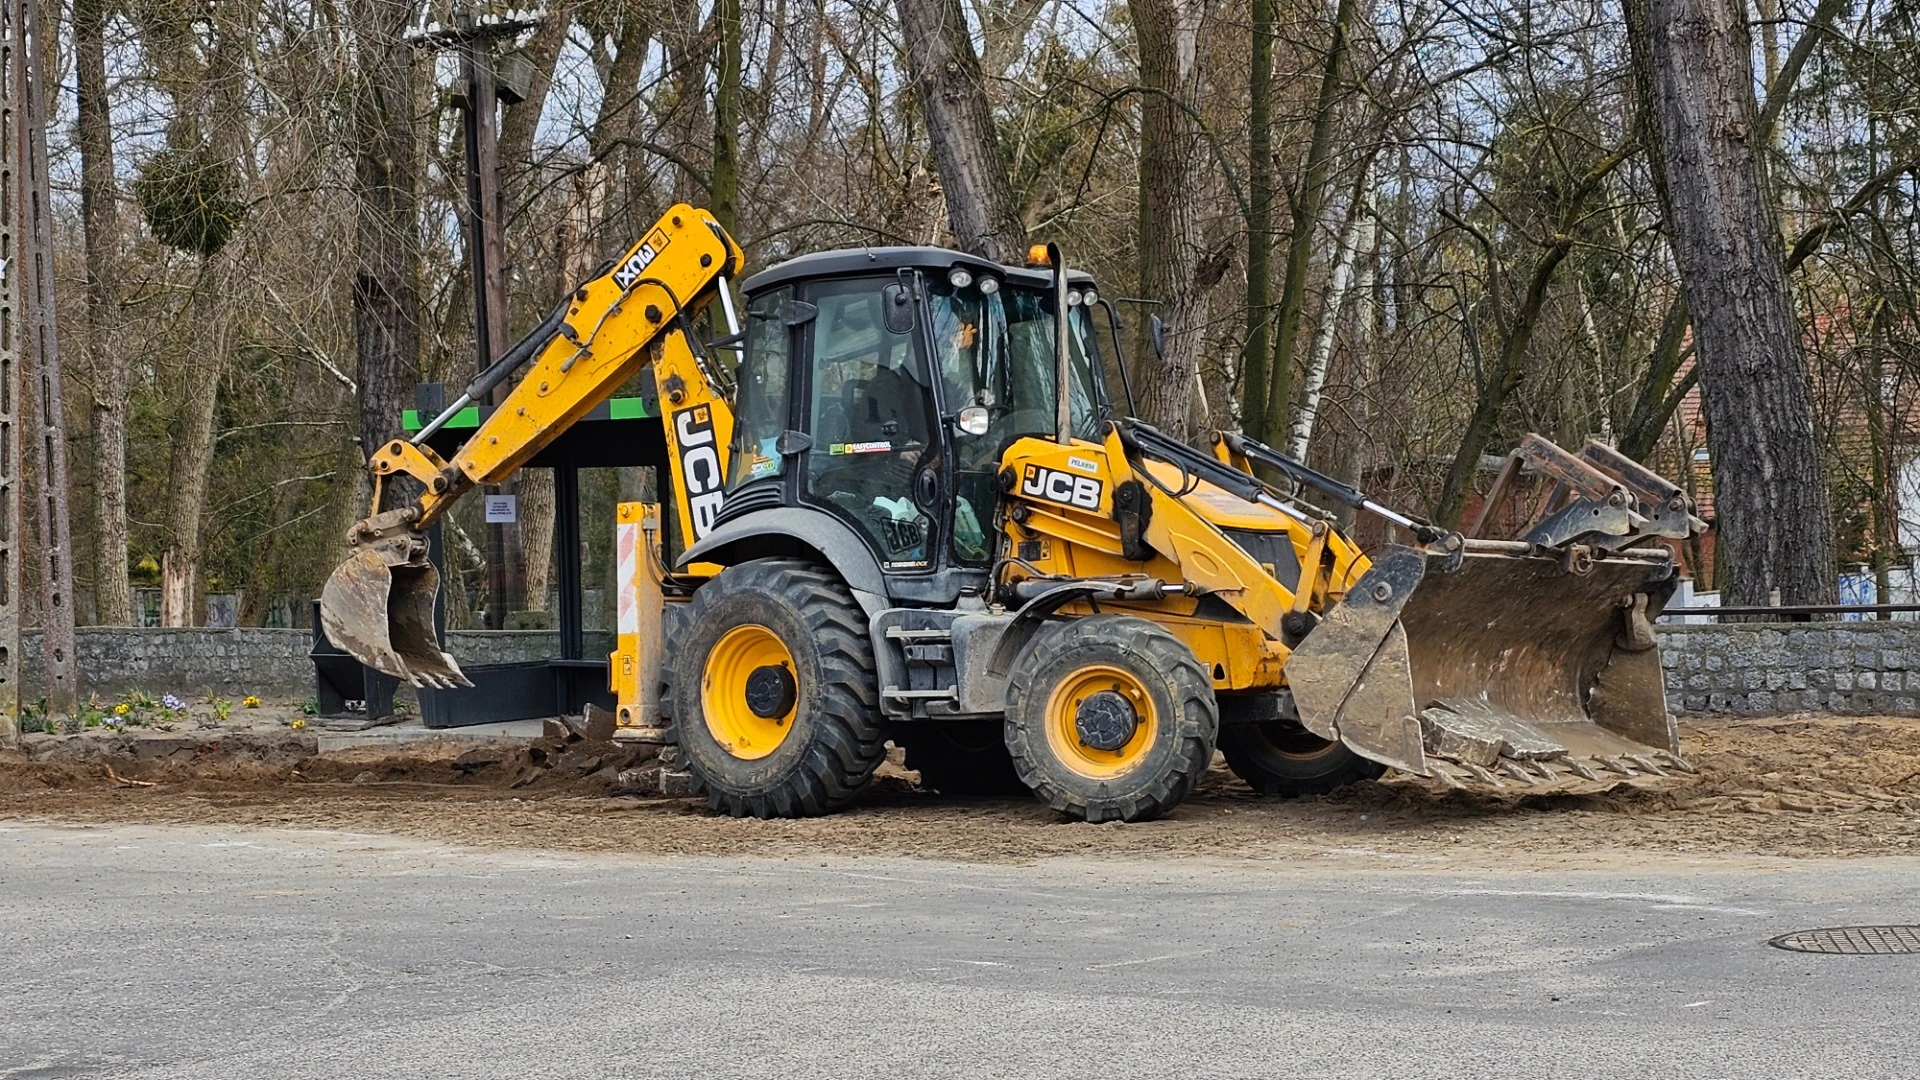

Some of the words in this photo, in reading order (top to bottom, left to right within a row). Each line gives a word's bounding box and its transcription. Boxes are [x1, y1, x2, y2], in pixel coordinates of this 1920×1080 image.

[616, 243, 657, 286] 3CX
[677, 411, 725, 540] JCB
[1024, 469, 1100, 508] JCB
[887, 521, 920, 550] JCB
